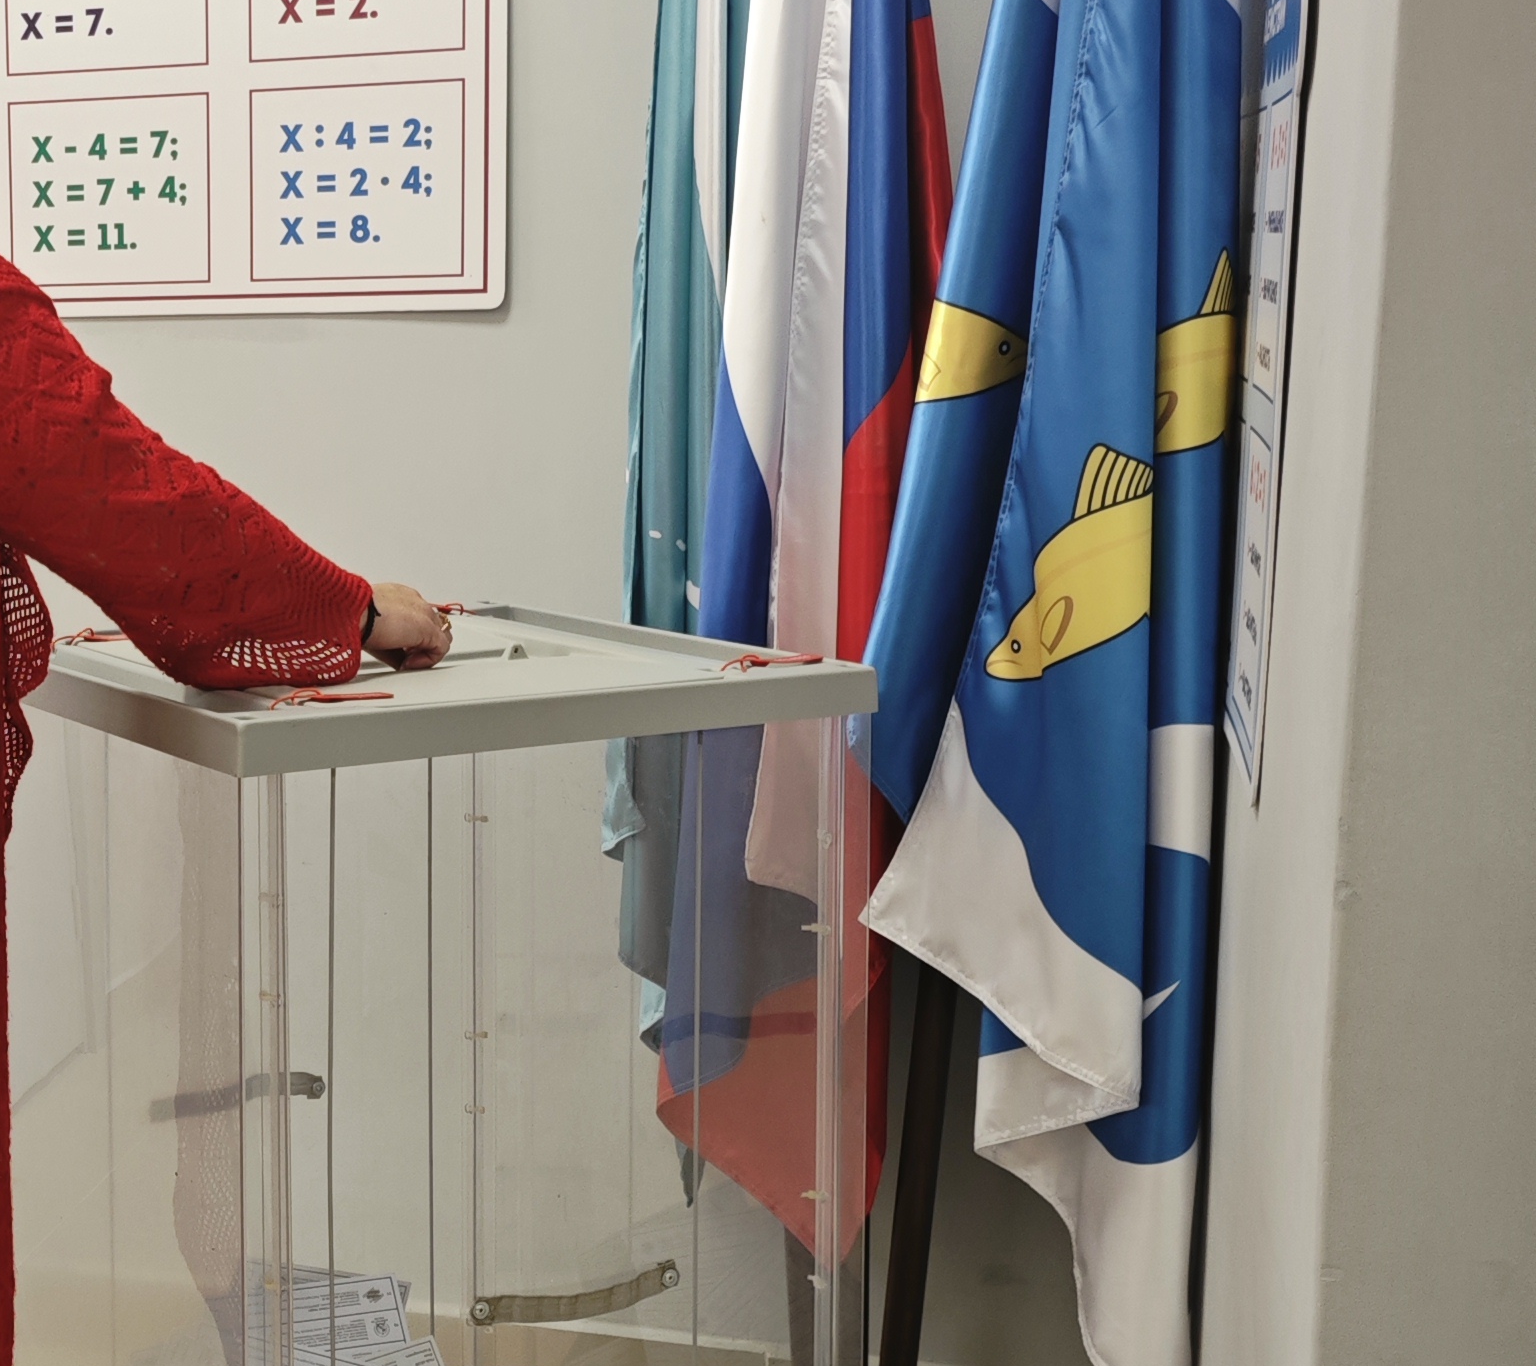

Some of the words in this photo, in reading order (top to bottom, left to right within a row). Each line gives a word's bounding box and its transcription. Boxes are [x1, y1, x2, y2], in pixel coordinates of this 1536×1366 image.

[54, 14, 74, 34] =
[85, 7, 114, 37] 7.
[87, 133, 108, 161] 4
[119, 136, 138, 155] =
[149, 130, 179, 161] 7;
[314, 124, 325, 148] :
[335, 121, 357, 151] 4
[369, 124, 389, 144] =
[402, 117, 433, 150] 2;
[66, 184, 85, 202] =
[96, 177, 116, 206] 7
[126, 180, 146, 201] +
[157, 175, 187, 206] 4;
[316, 174, 336, 193] =
[349, 167, 369, 197] 2
[400, 165, 433, 198] 4;
[67, 228, 86, 247] =
[97, 222, 138, 251] 11.
[316, 220, 337, 240] =
[349, 214, 381, 244] 8.
